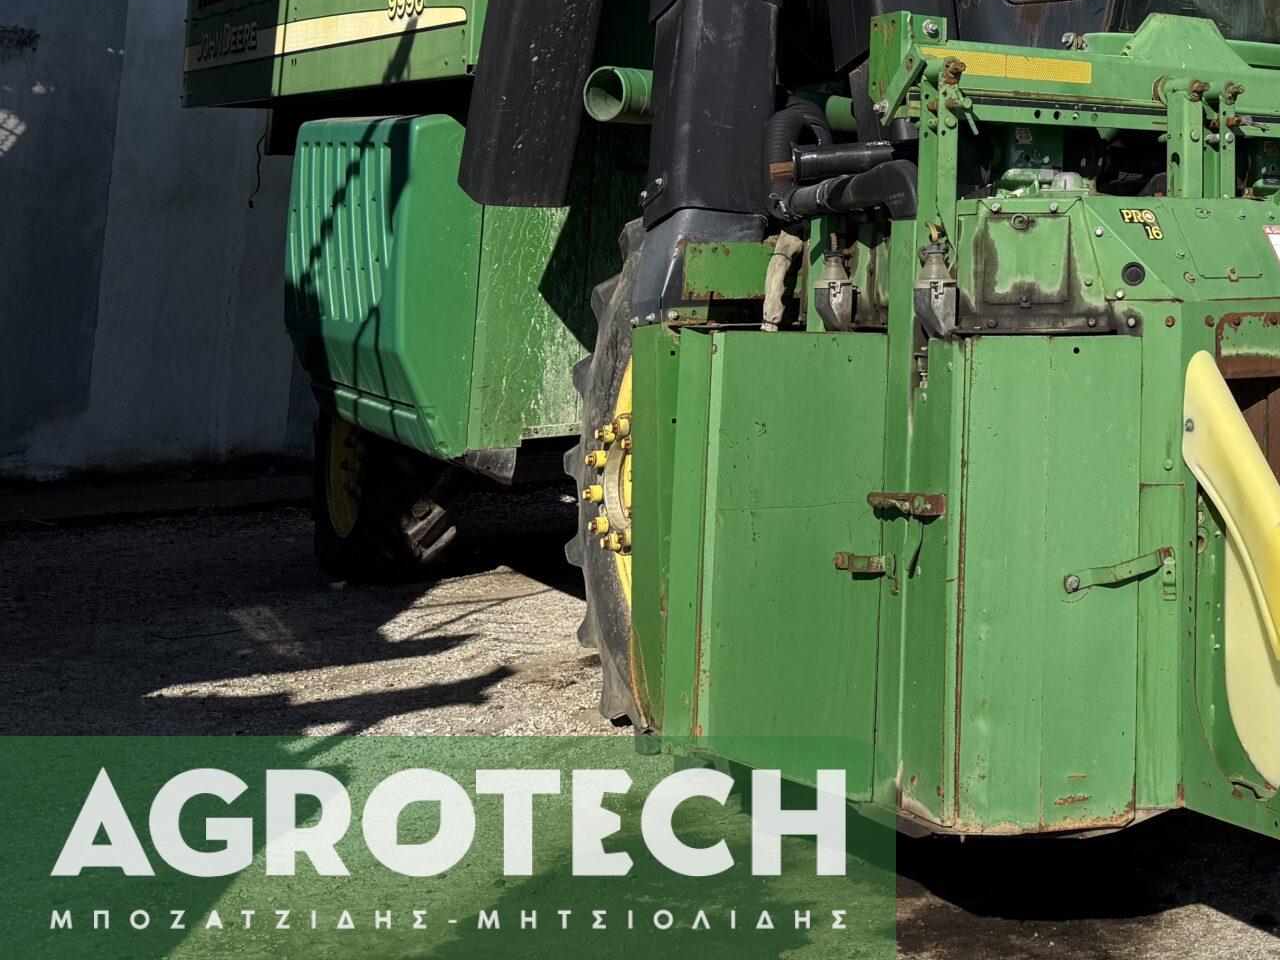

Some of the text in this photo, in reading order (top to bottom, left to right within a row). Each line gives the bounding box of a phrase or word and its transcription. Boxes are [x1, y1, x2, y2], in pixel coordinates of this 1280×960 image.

[197, 21, 258, 62] JOHN DEERE
[1120, 209, 1156, 223] PRO
[1145, 226, 1163, 240] 16
